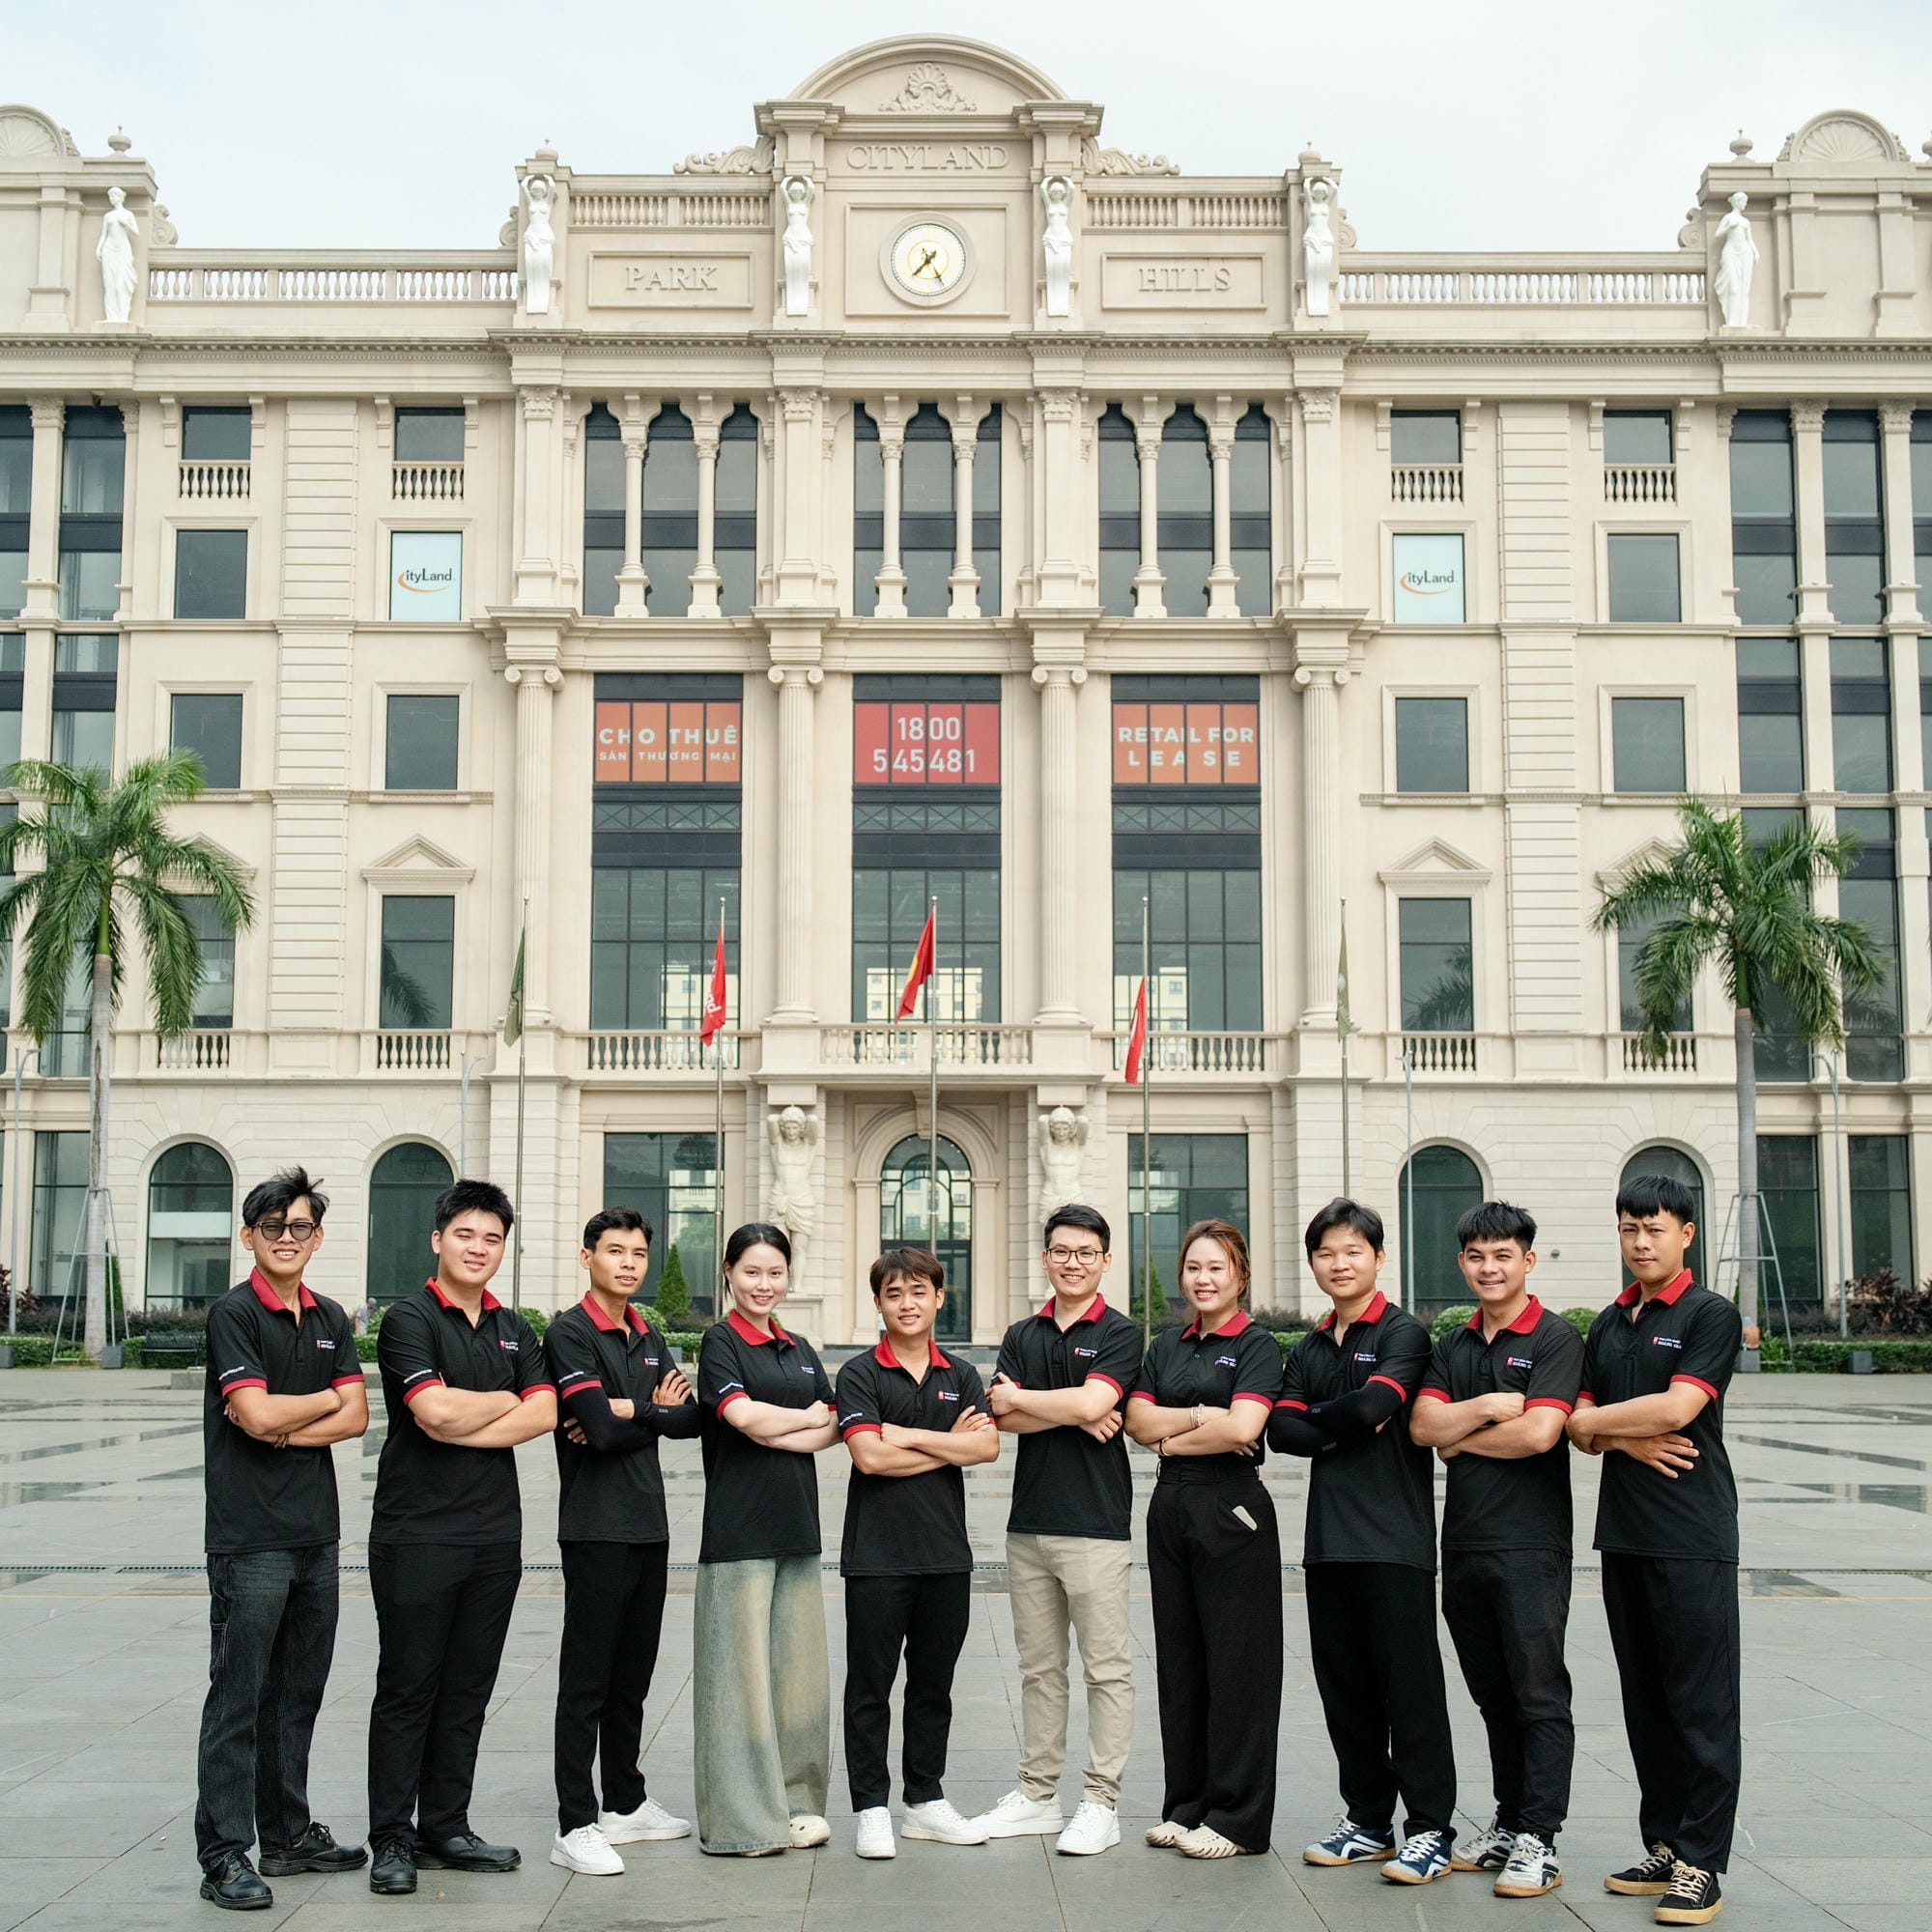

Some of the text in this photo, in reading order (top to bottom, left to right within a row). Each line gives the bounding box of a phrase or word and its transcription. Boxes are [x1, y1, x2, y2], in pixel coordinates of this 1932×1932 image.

[846, 146, 1010, 170] CITYLAND
[625, 267, 718, 291] PARK
[1139, 268, 1231, 292] HILLS
[599, 724, 738, 745] CHO THUÊ
[897, 717, 960, 741] 1800
[1118, 727, 1254, 743] RETAIL FOR
[872, 749, 975, 773] 545481
[1128, 750, 1241, 766] LEASE
